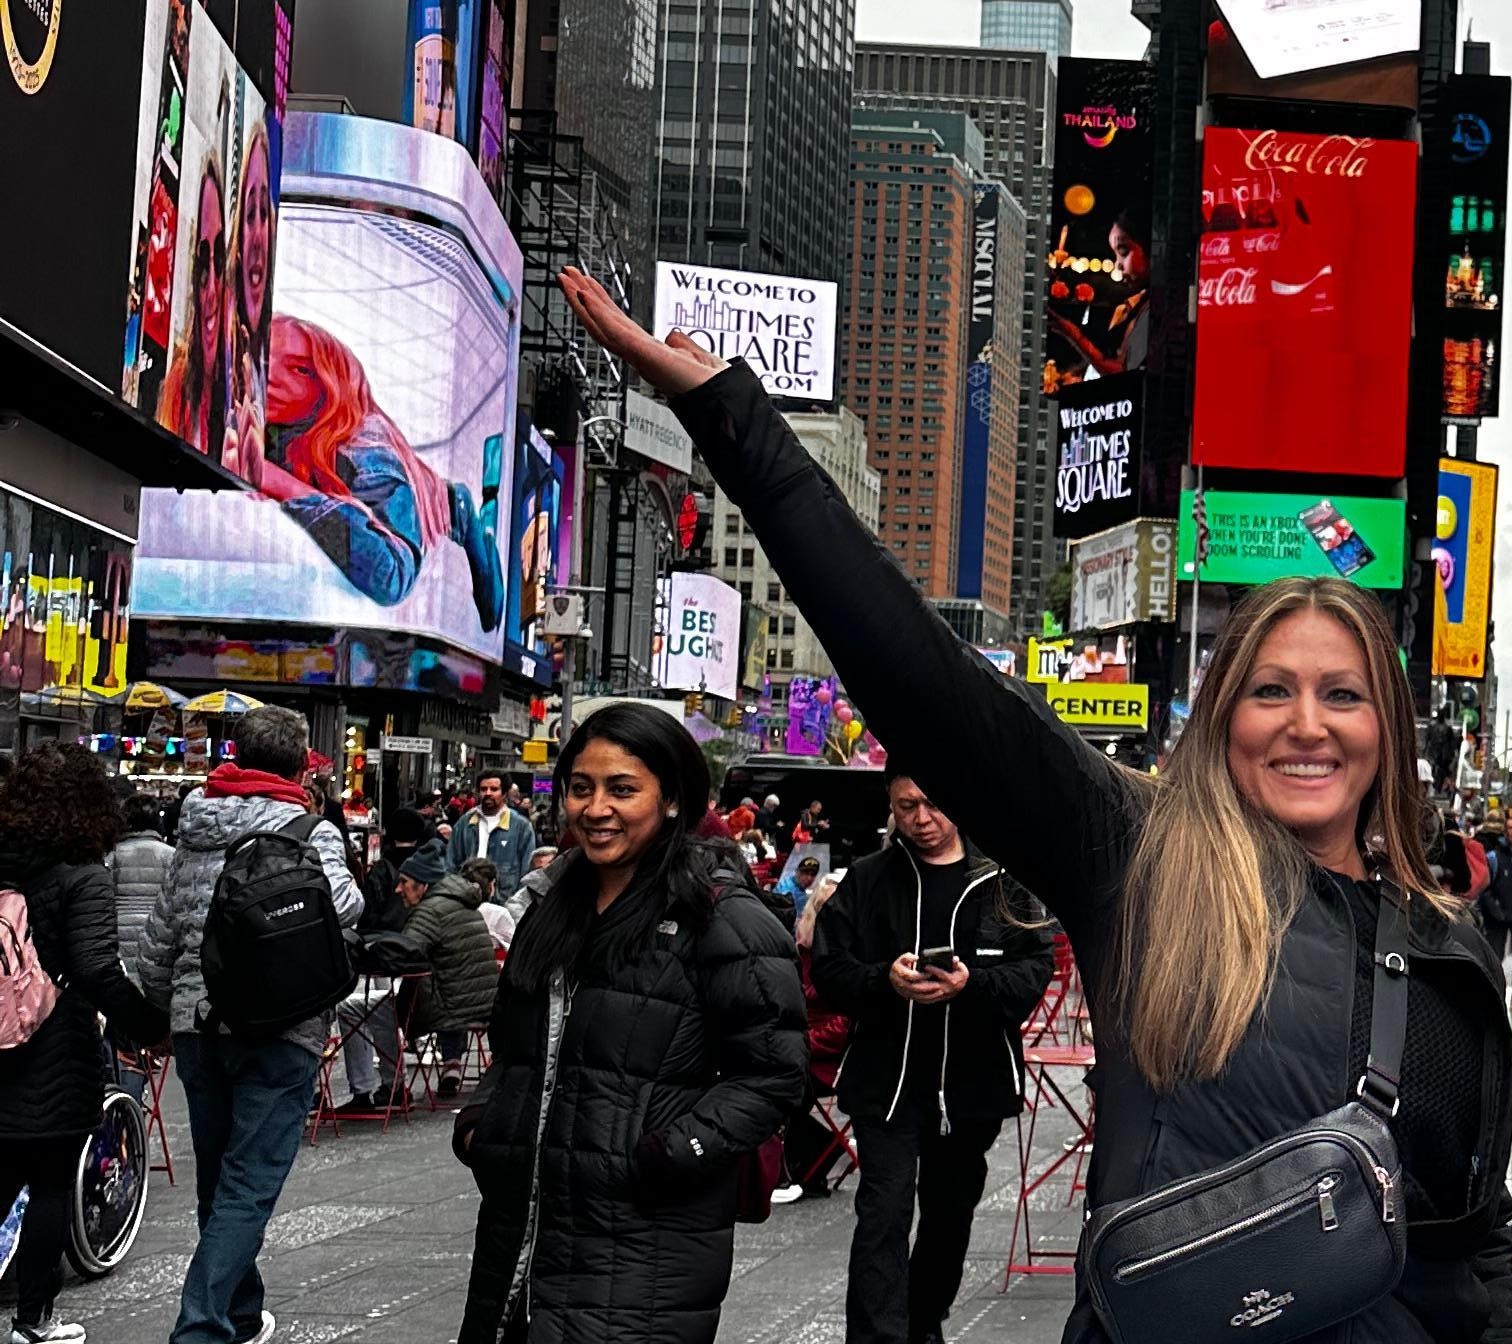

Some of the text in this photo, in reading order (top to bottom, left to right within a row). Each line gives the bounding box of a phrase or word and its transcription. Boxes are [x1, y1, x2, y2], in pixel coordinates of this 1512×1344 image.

[1063, 112, 1137, 129] THAILAND
[671, 269, 816, 304] WELCOME TO
[731, 307, 815, 340] TIMES
[629, 412, 654, 436] HYATT
[1060, 399, 1133, 430] WELCOME TO
[1087, 429, 1131, 459] TIMES
[1212, 512, 1237, 528] THIS
[1239, 514, 1250, 528] IS
[1252, 515, 1268, 529] AN
[1239, 530, 1276, 544] YOU'RE
[1279, 531, 1307, 545] DONE
[1241, 543, 1301, 560] SCROLLING
[1149, 526, 1173, 617] HELLO!
[1051, 697, 1143, 717] CENTER
